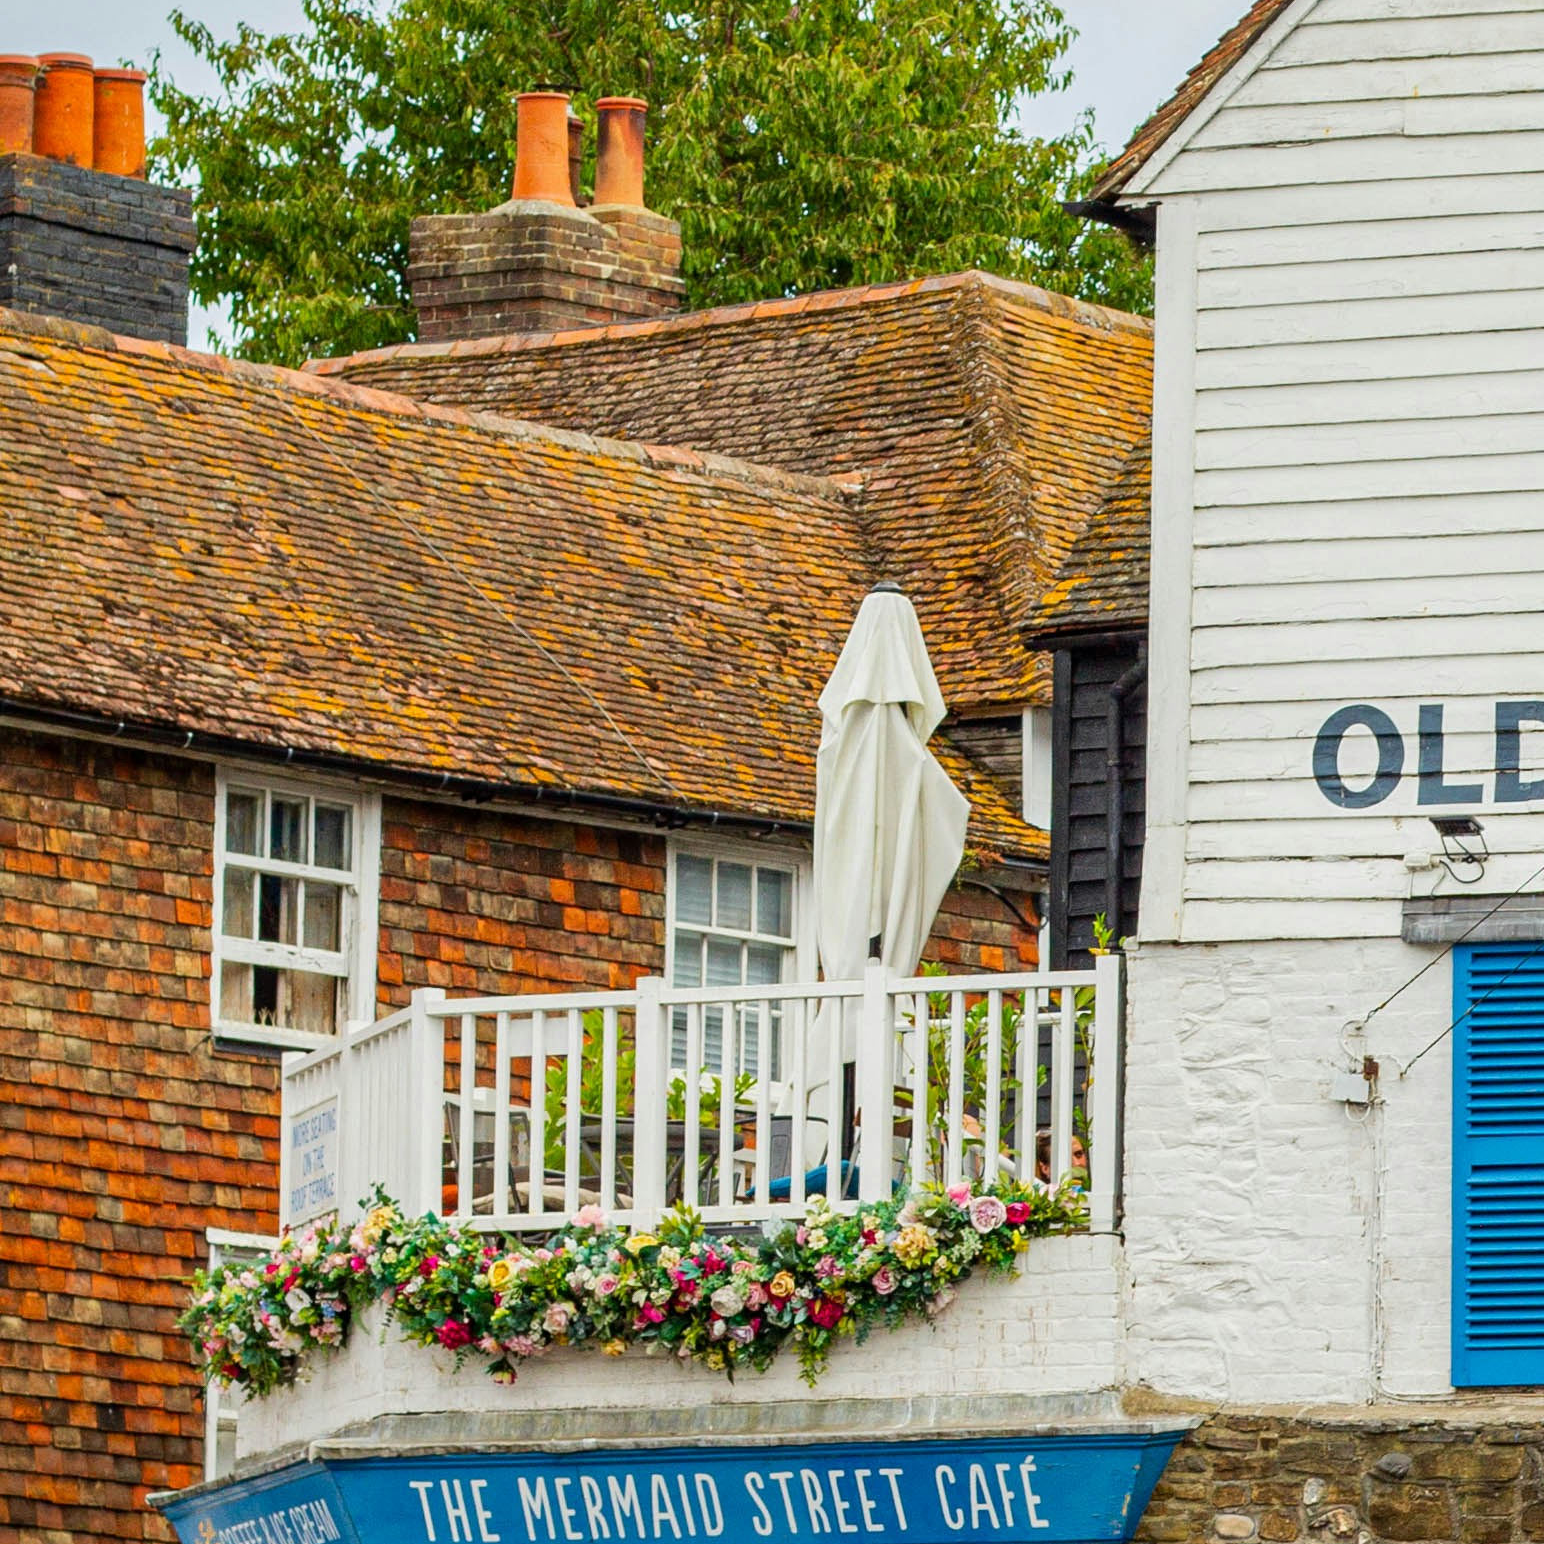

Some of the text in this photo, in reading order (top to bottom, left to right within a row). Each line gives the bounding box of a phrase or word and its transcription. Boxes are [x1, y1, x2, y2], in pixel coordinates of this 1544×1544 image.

[292, 1108, 336, 1149] MORE SEATING
[409, 1455, 1050, 1543] THE MERMAID STREET CAFÉ
